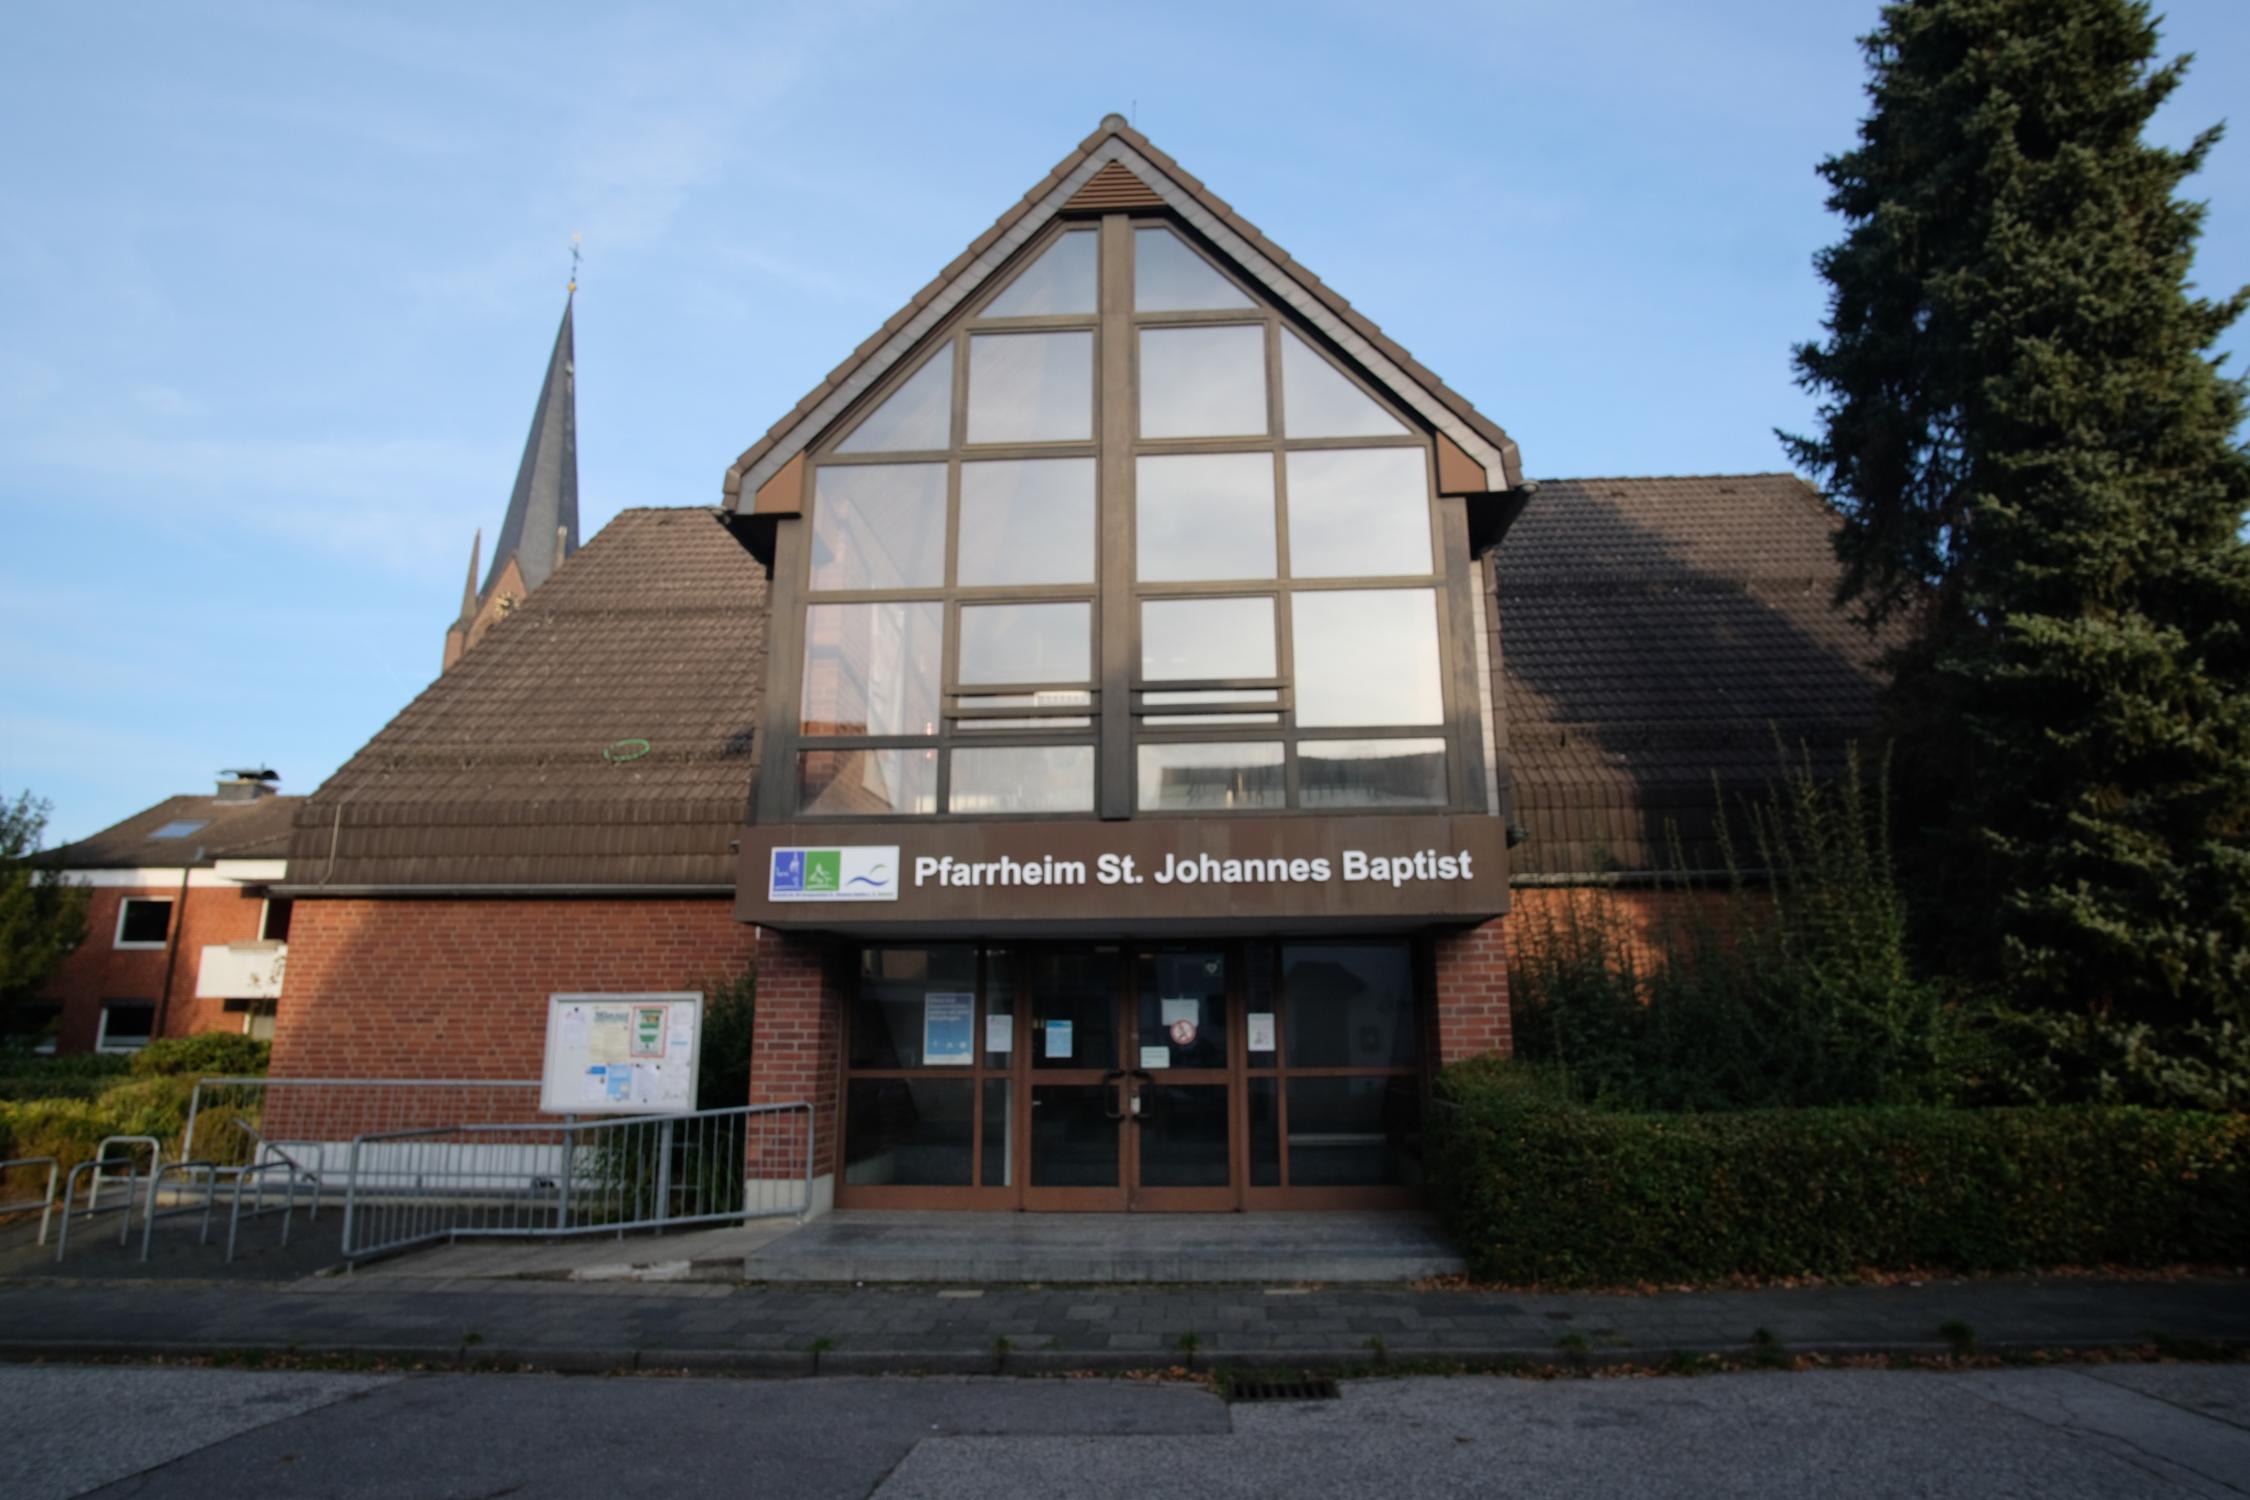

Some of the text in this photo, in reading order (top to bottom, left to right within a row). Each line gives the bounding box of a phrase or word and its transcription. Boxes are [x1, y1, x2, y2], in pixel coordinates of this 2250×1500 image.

[913, 848, 1474, 888] Pfarrheim St. Johannes Baptist
